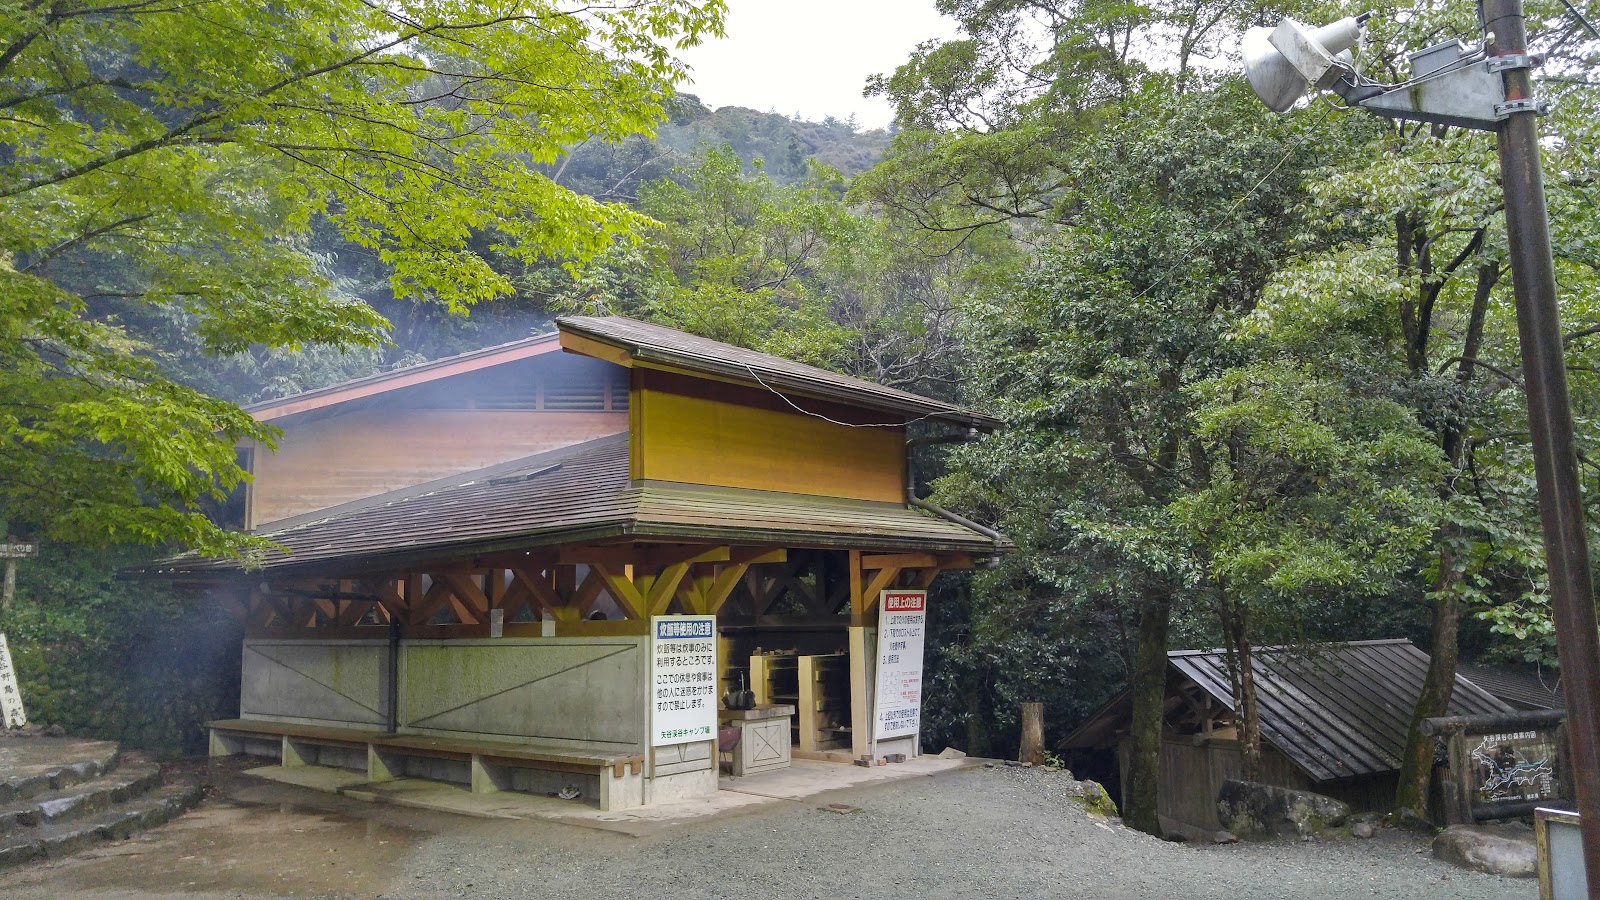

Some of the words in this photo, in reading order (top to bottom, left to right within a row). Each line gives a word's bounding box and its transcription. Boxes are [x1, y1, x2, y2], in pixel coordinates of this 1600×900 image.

[888, 597, 922, 609] 使用上の注意
[660, 622, 711, 637] 炊飯等使用の注意
[657, 643, 712, 654] 炊飯等は炊事のみに
[657, 655, 714, 667] 利用するところです。
[657, 672, 713, 684] ここでの休息や食事は
[657, 685, 713, 698] 他の人に迷惑をかけま
[657, 698, 704, 712] すので禁止します。
